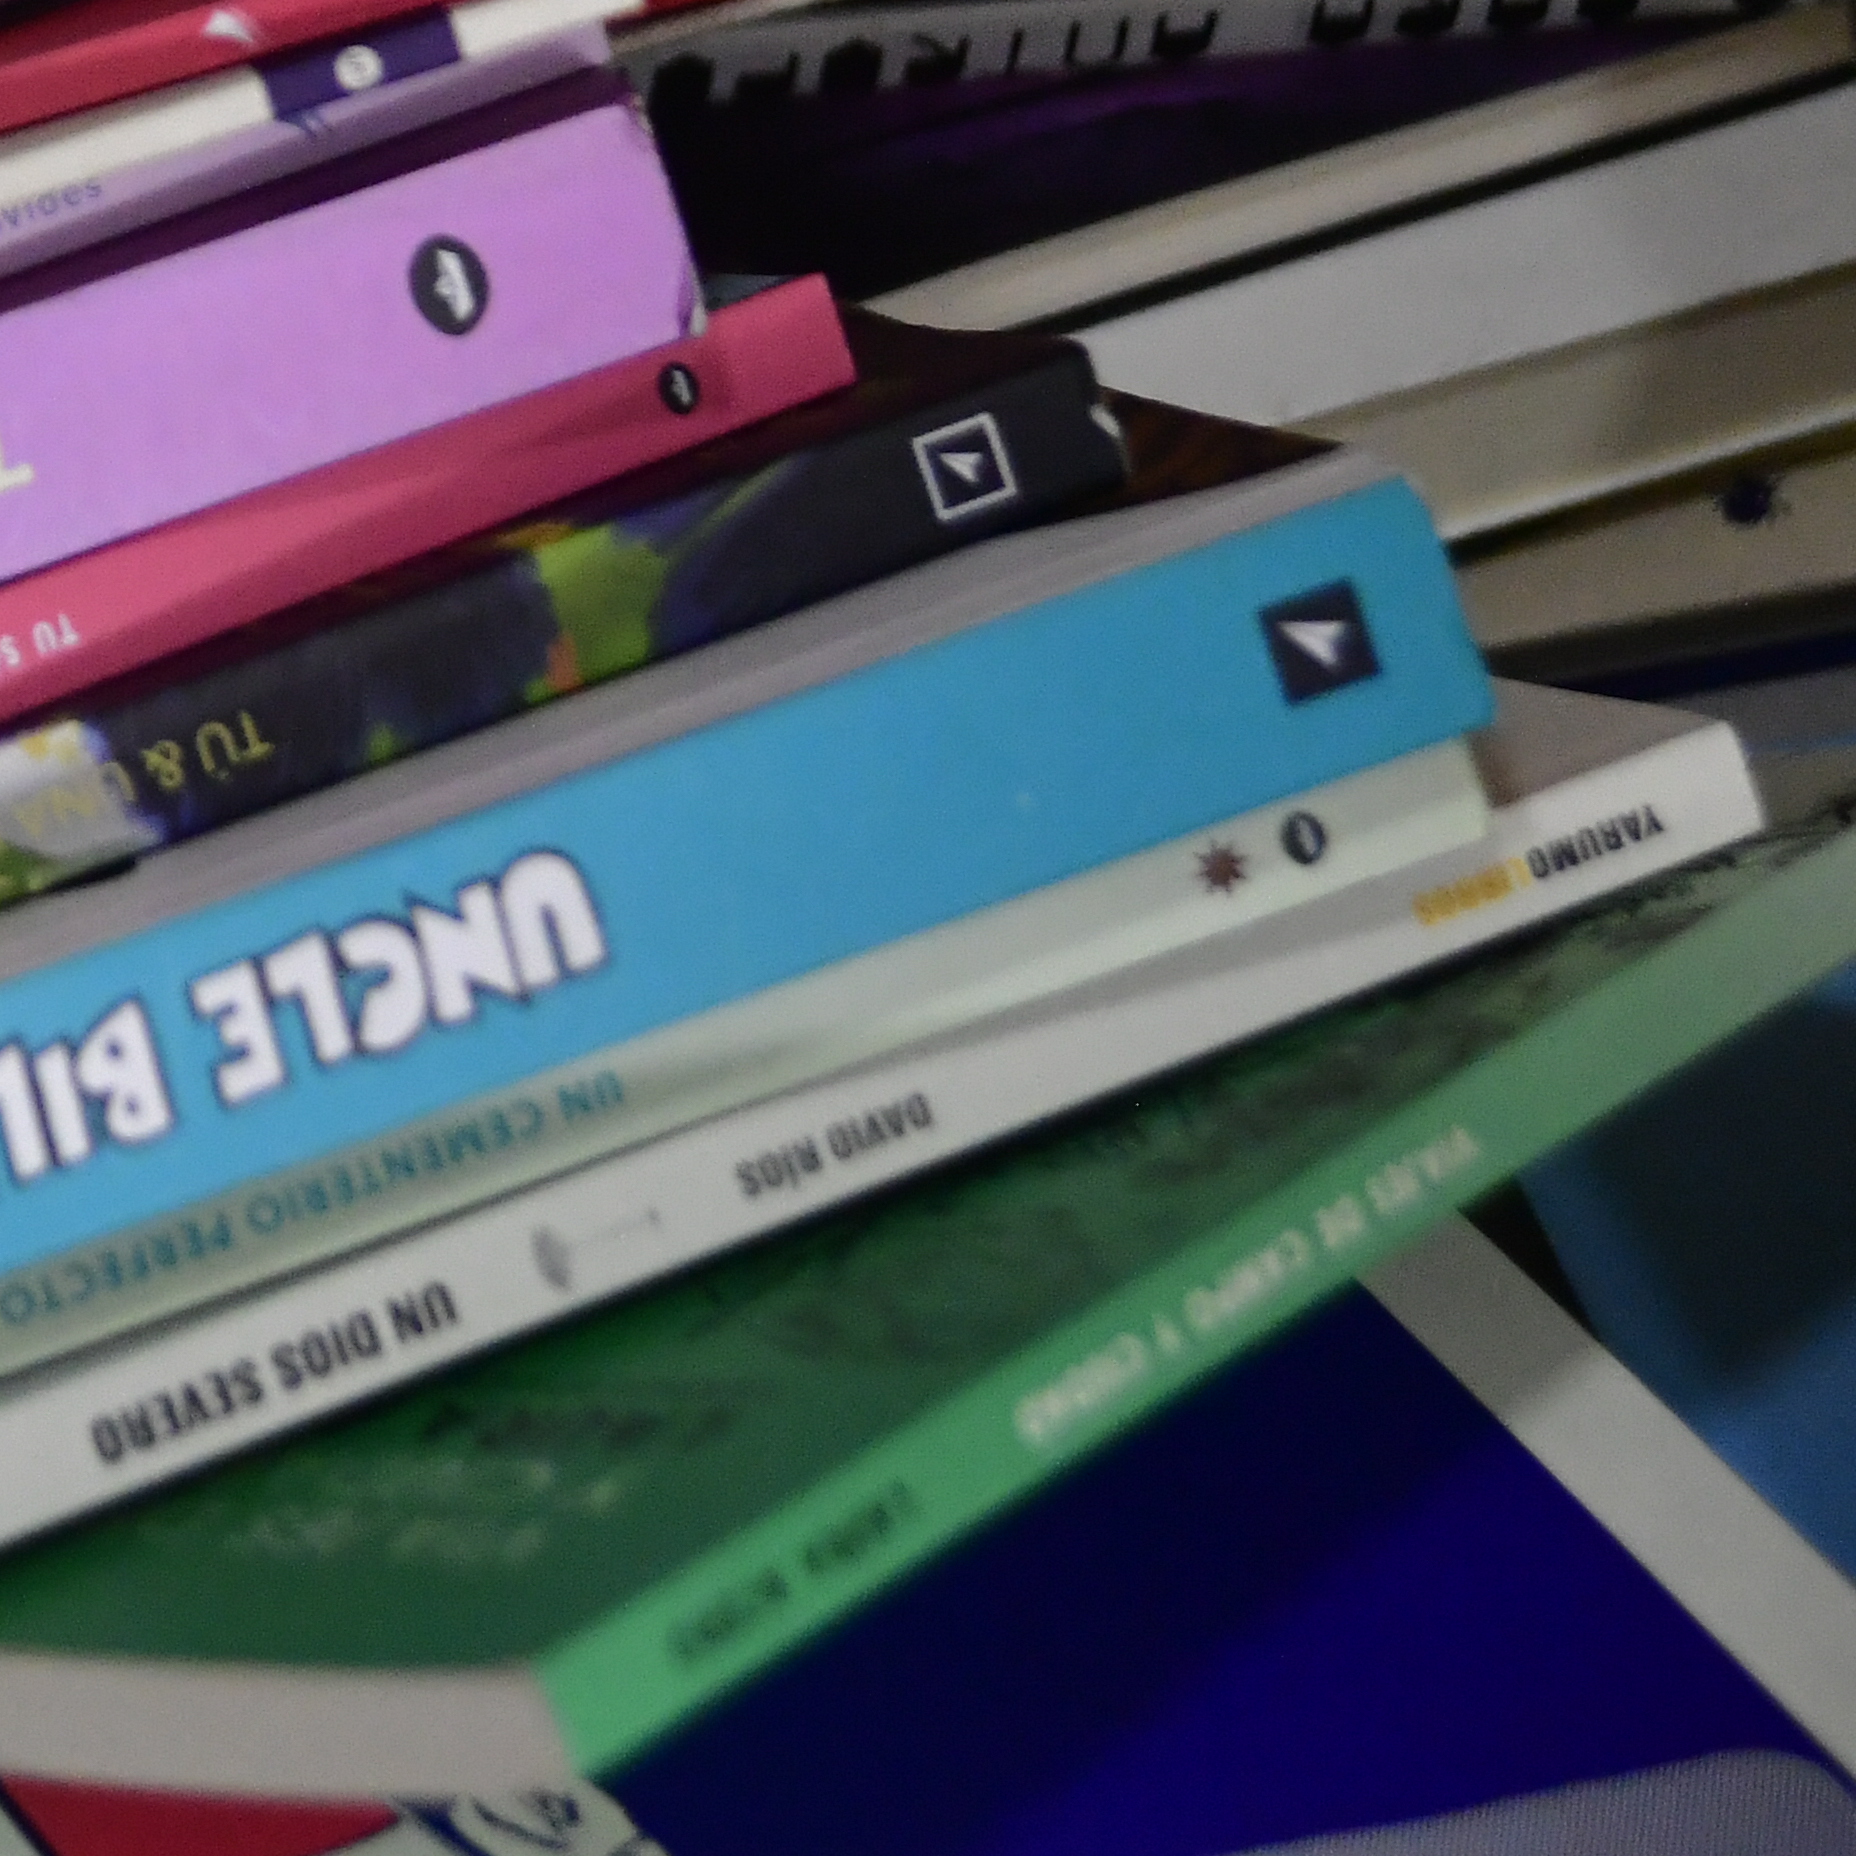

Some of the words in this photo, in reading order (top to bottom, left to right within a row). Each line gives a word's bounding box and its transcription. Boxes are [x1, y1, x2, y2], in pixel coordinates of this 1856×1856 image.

[23, 605, 85, 660] TU
[136, 733, 194, 799] &
[1529, 810, 1664, 879] YARUMO
[197, 848, 600, 1098] UNCLE
[548, 1063, 624, 1123] UN
[828, 1094, 933, 1161] DAVID
[246, 1091, 544, 1235] CEMENTERIO
[737, 1139, 823, 1198] RÍOS
[0, 1213, 233, 1324] PERFECTO
[380, 1274, 465, 1351] UN
[272, 1313, 382, 1390] DIOS
[92, 1362, 264, 1464] SEVERO
